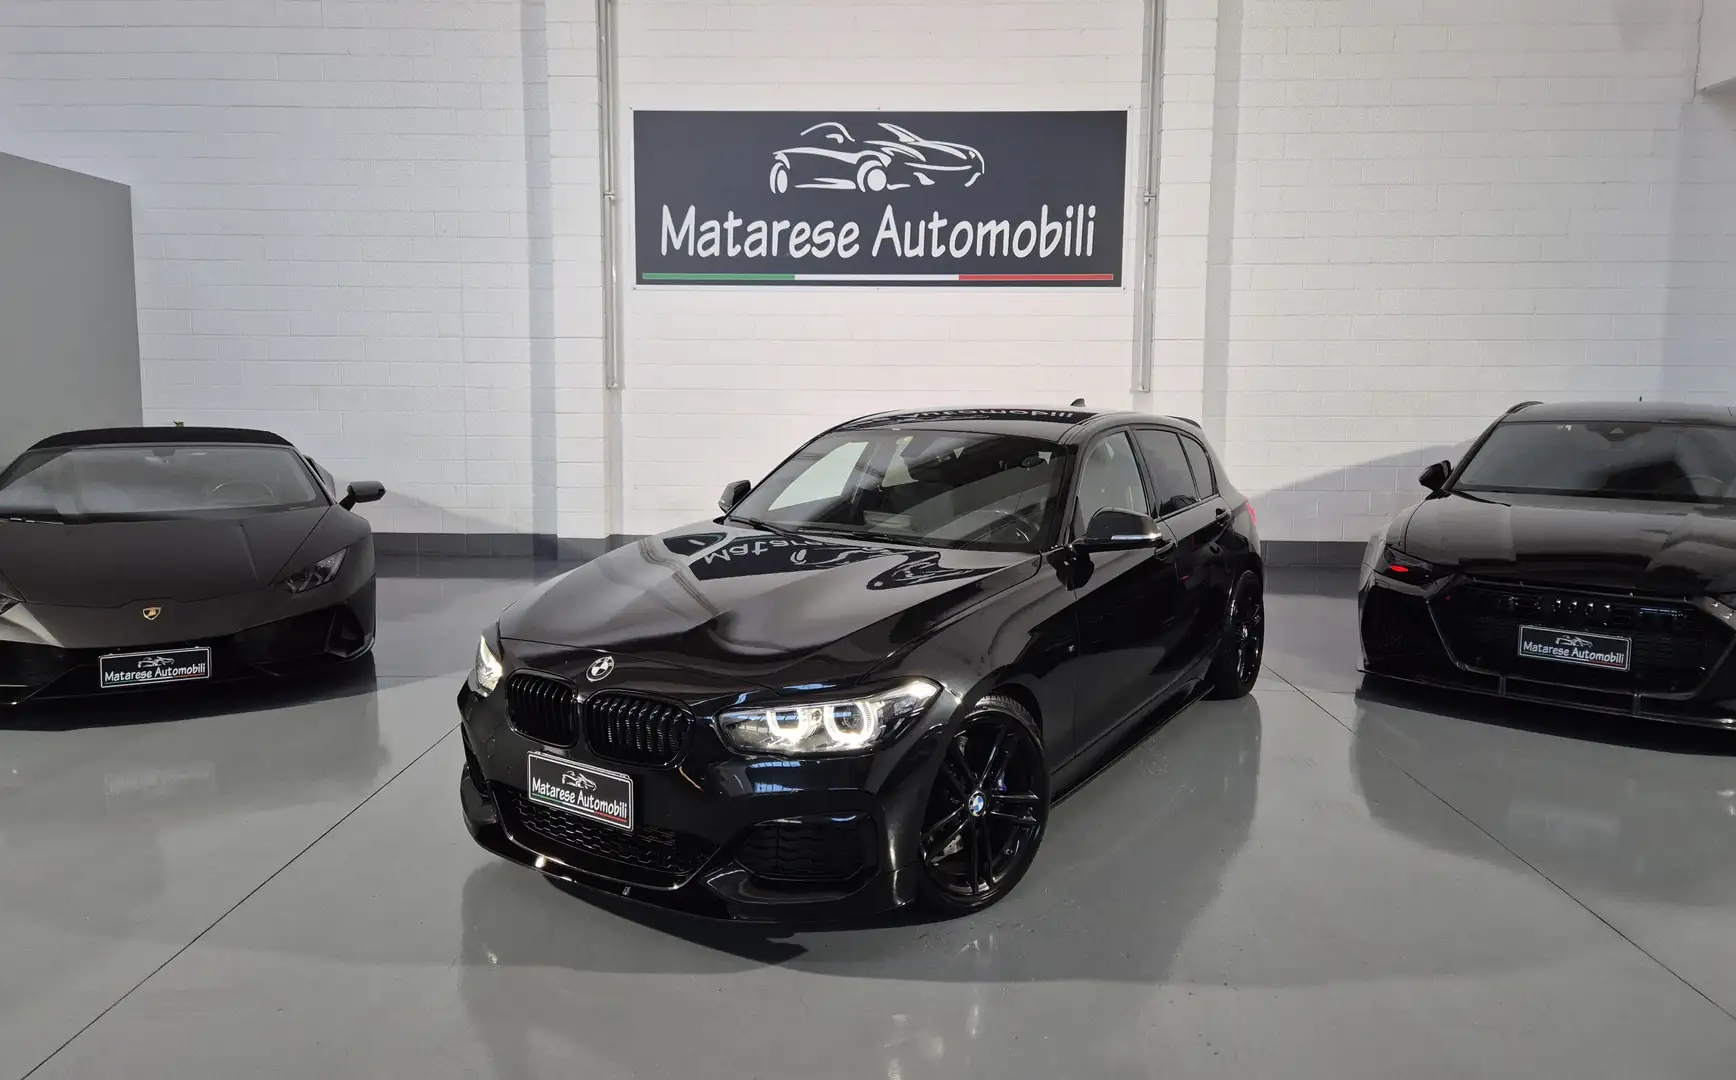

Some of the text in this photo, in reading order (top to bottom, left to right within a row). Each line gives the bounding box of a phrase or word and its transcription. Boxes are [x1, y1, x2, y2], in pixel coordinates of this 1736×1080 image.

[661, 204, 1096, 258] Matarese Automobili
[1523, 641, 1624, 664] Matarese Automobili
[104, 663, 206, 682] Matarese Automobili
[532, 777, 627, 819] Matarese Automobili
